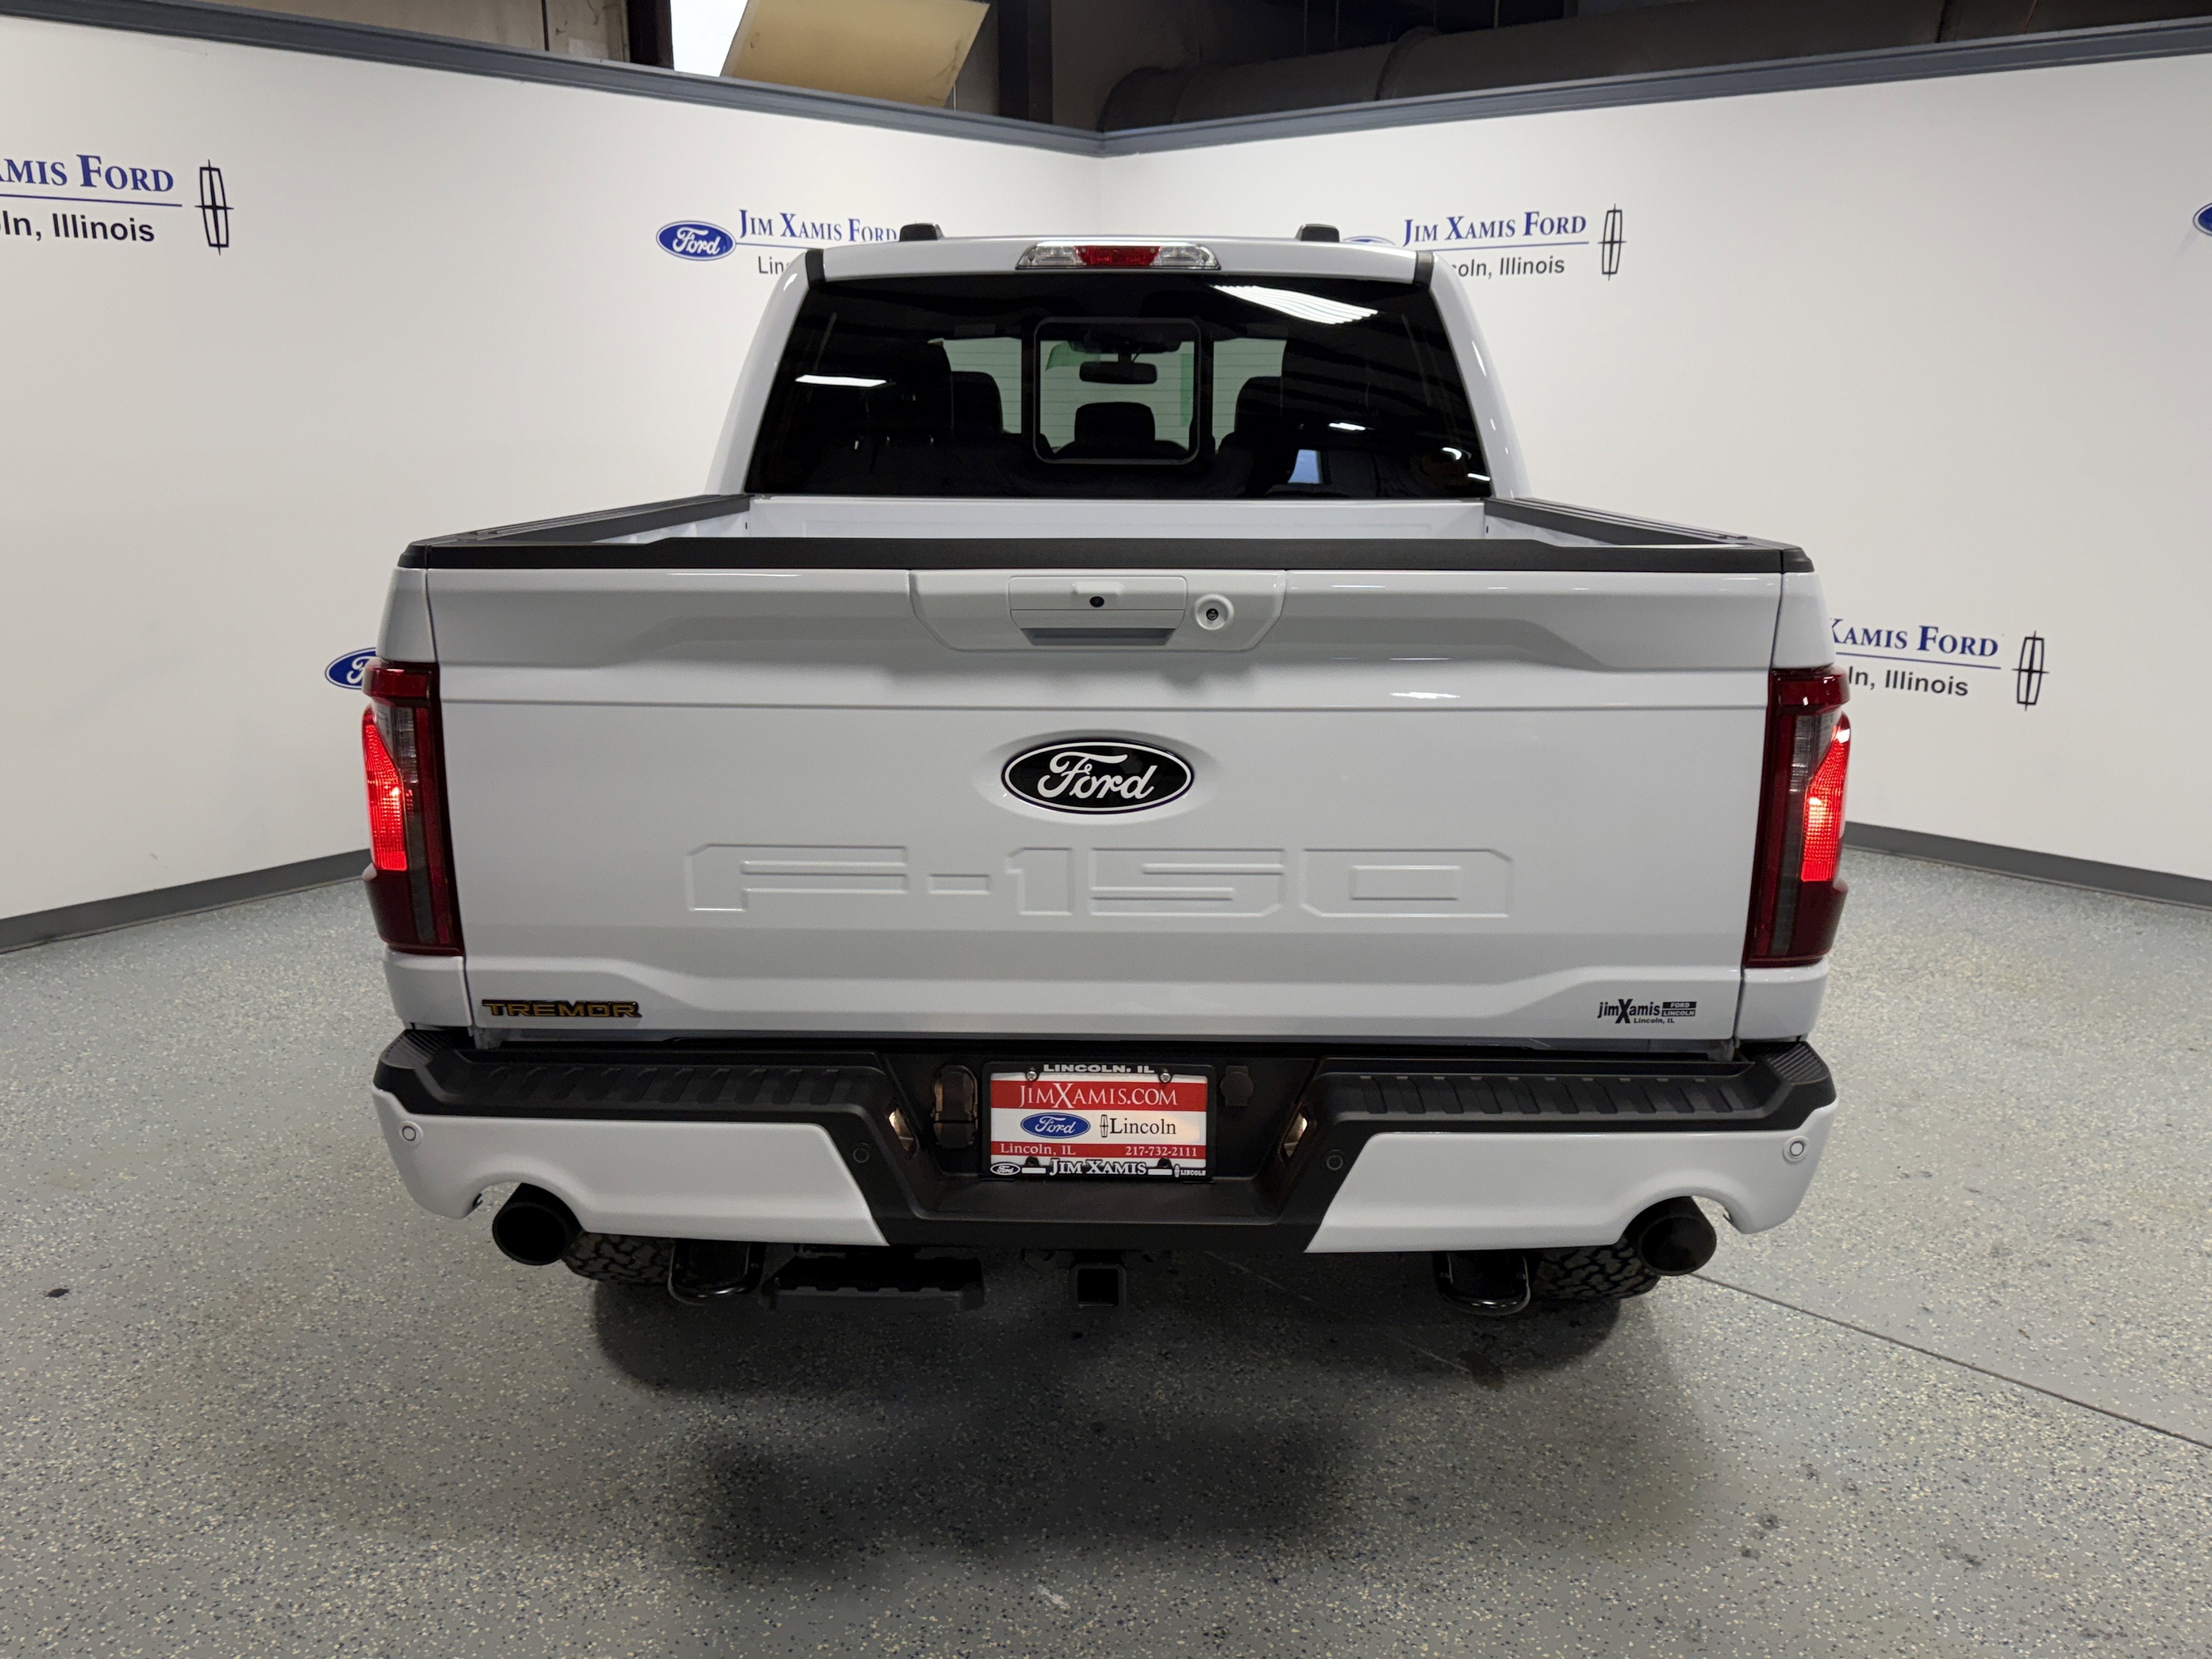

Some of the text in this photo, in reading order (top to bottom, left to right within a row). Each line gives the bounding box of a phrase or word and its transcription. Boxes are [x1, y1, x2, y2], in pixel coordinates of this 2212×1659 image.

[0, 154, 174, 192] MIS FORD
[0, 210, 155, 242] ln, Illinois
[738, 209, 897, 241] JIM XAMIS FORD
[1402, 211, 1587, 247] JIM XAMIS FORD
[672, 227, 721, 255] Ford
[758, 256, 789, 275] Lin
[1452, 255, 1565, 280] oln, Illinois
[1916, 625, 1999, 657] FORD
[1884, 669, 1969, 696] Illinois
[1037, 751, 1158, 799] Ford
[685, 843, 1514, 921] F-150
[482, 999, 642, 1018] TREMOR
[1597, 998, 1661, 1024] jimXamis
[1043, 1064, 1155, 1074] LINCOLN, IL
[1019, 1082, 1178, 1109] JIMXAMIS.COM
[1035, 1117, 1076, 1135] Ford
[1109, 1118, 1177, 1135] Lincoln
[1000, 1143, 1076, 1156] Lincoln, IL
[1125, 1146, 1197, 1157] 217-732-2111
[996, 1165, 1014, 1174] Ford
[1049, 1158, 1147, 1176] JIM XAMIS
